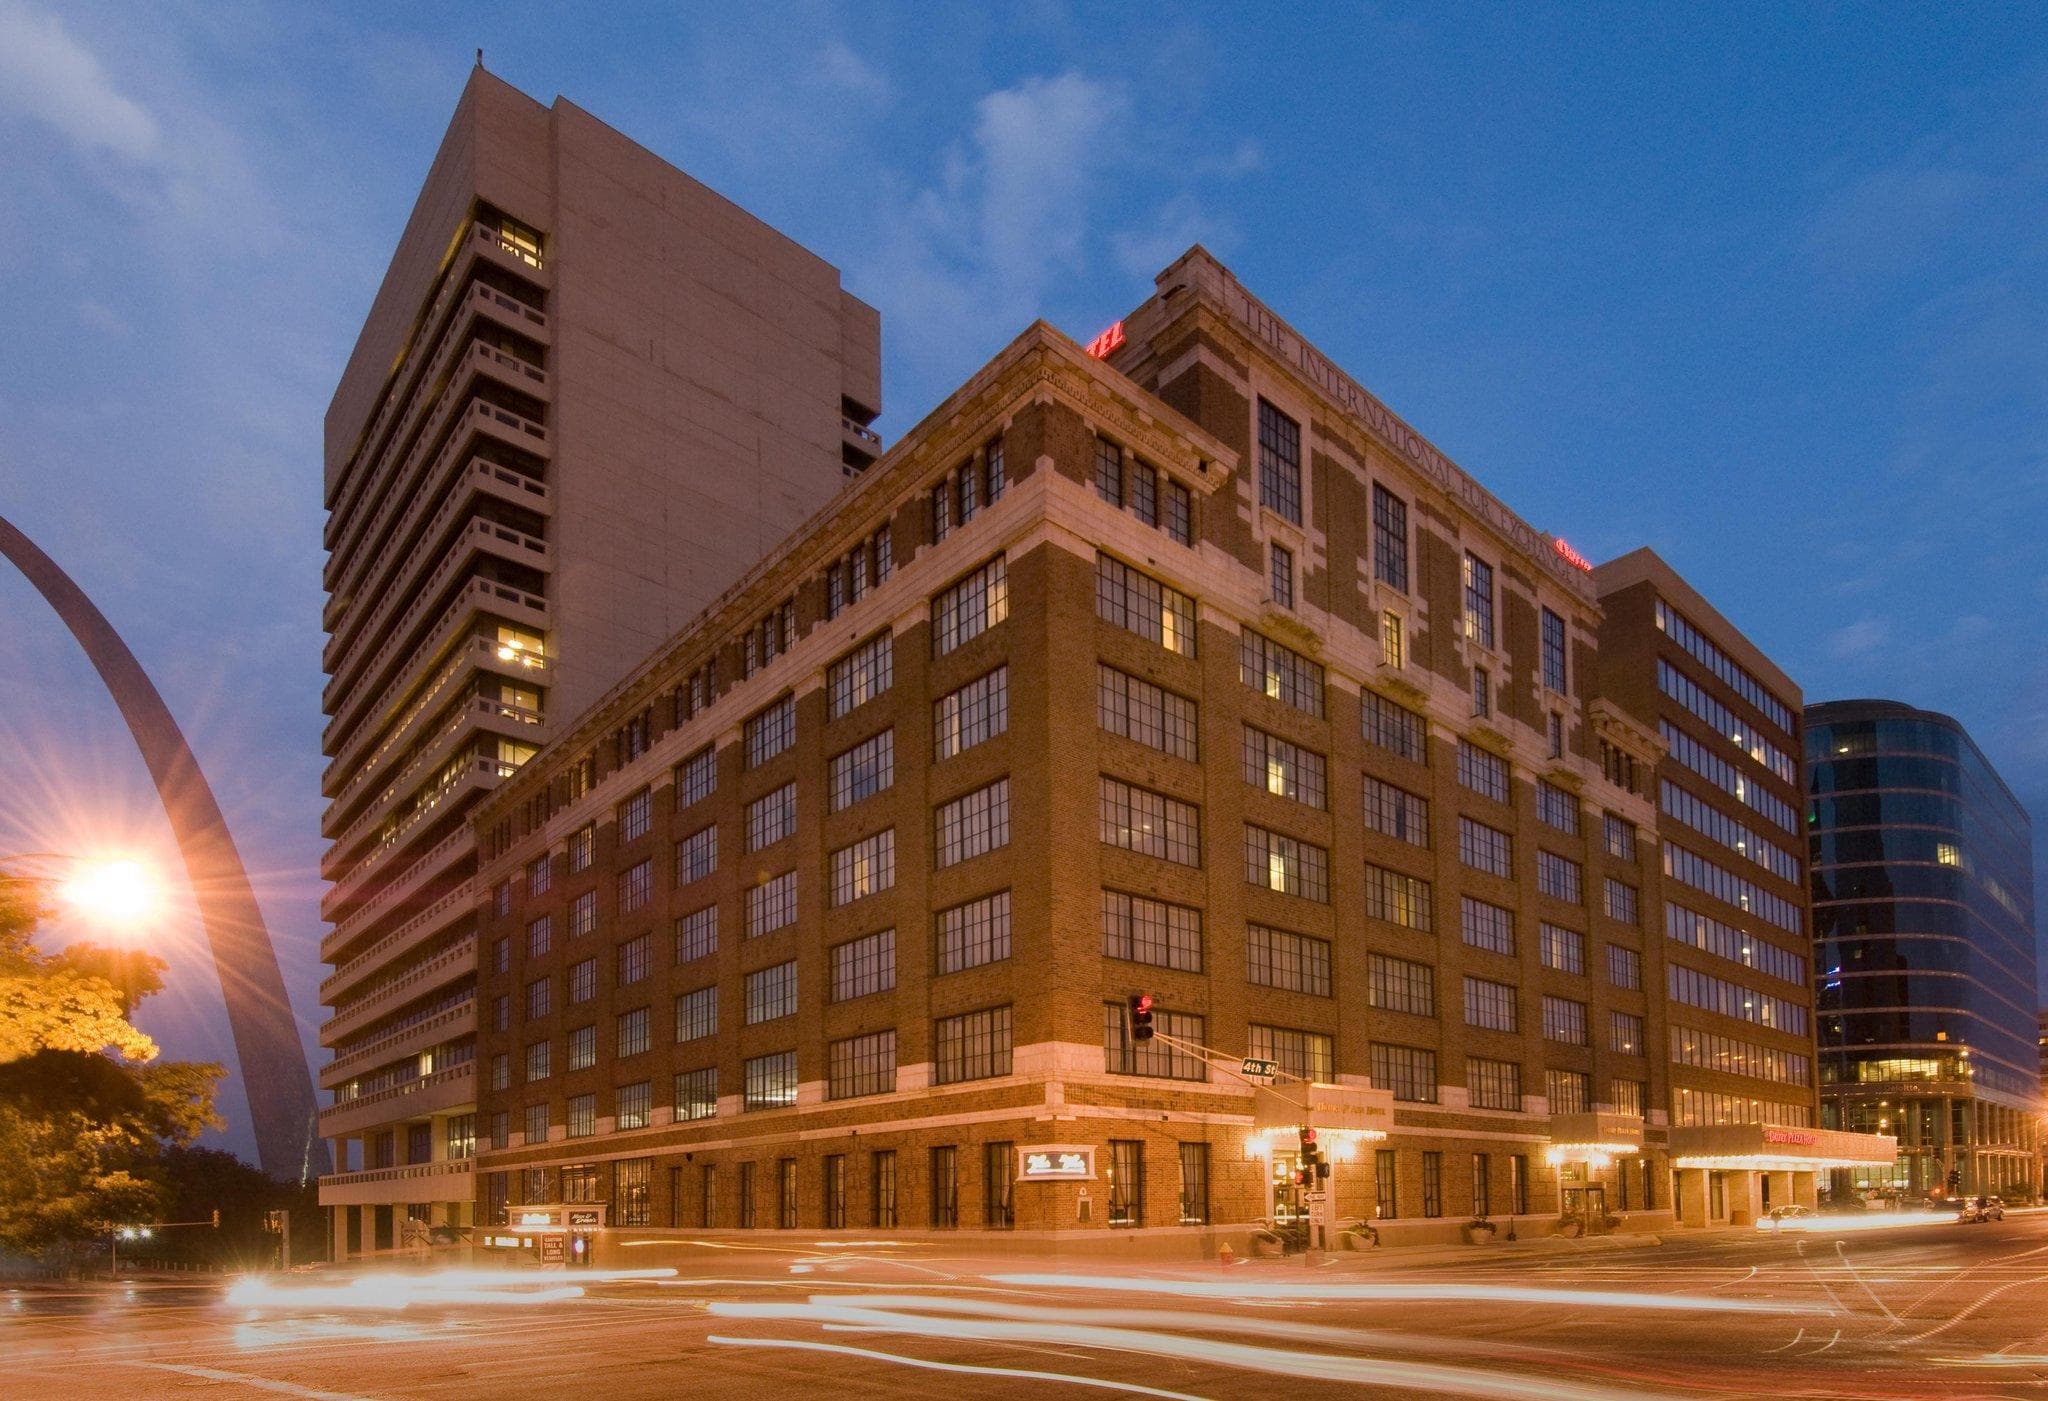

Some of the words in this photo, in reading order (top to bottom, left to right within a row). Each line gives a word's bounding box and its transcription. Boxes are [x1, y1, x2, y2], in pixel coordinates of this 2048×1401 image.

[1242, 296, 1288, 356] THE
[1300, 345, 1455, 492] INTERNATIONAL
[1462, 477, 1493, 523] FUR
[1243, 1061, 1262, 1074] 4th
[1264, 1065, 1276, 1076] St
